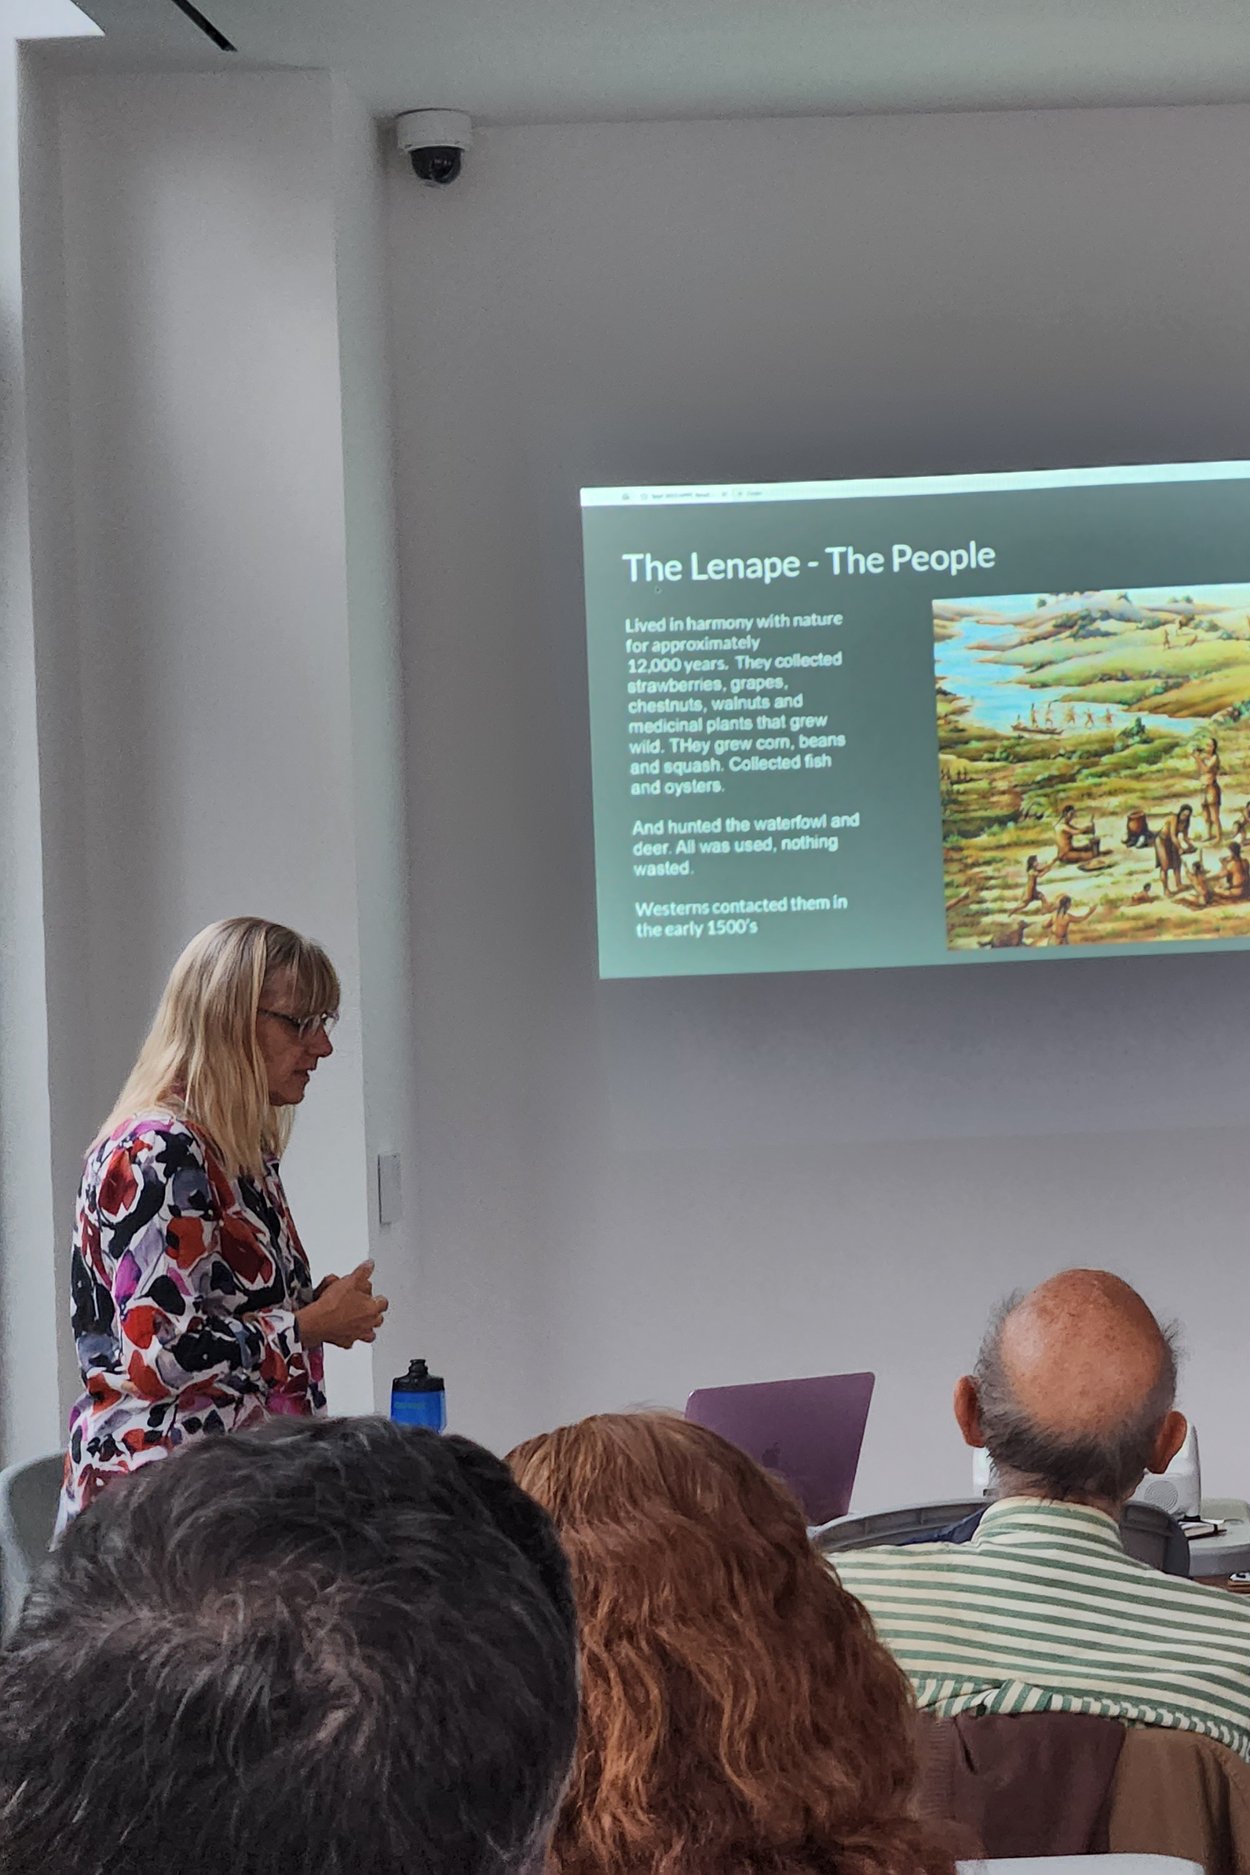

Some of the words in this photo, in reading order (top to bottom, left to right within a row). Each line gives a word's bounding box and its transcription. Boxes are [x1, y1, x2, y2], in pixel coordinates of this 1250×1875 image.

[622, 553, 682, 582] The
[691, 552, 800, 583] Lenape
[825, 546, 884, 574] The
[892, 541, 996, 575] People
[625, 618, 666, 633] Lived
[670, 617, 684, 631] in
[686, 615, 752, 632] harmony
[756, 614, 790, 629] with
[793, 613, 842, 627] nature
[626, 639, 648, 654] for
[652, 636, 760, 654] approximately
[628, 658, 681, 673] 12,000
[684, 658, 728, 673] years.
[735, 655, 771, 671] They
[775, 651, 842, 668] collected
[628, 678, 727, 694] strawberries,
[731, 677, 788, 692] grapes,
[629, 698, 707, 714] chestnuts,
[711, 696, 770, 711] walnuts
[774, 694, 803, 708] and
[629, 718, 702, 734] medicinal
[706, 716, 752, 734] plants
[757, 715, 786, 729] that
[790, 714, 827, 731] grew
[629, 739, 665, 754] wild.
[714, 736, 752, 754] grew
[756, 737, 795, 752] corn,
[799, 734, 845, 749] beans
[630, 759, 660, 775] and
[664, 757, 724, 775] squash.
[729, 755, 801, 772] Collected
[804, 753, 832, 768] fish
[631, 780, 660, 795] and
[664, 780, 724, 796] oysters.
[632, 820, 664, 835] And
[668, 818, 722, 834] hunted
[726, 817, 750, 832] the
[754, 814, 826, 830] waterfowl
[831, 813, 860, 828] and
[633, 840, 671, 856] deer.
[675, 839, 696, 854] All
[700, 840, 730, 853] was
[734, 837, 777, 853] used,
[781, 835, 839, 852] nothing
[634, 860, 694, 876] wasted.
[635, 900, 709, 917] Westerns
[713, 897, 788, 914] contacted
[790, 896, 830, 912] them
[833, 895, 847, 910] in
[636, 922, 663, 937] the
[665, 922, 704, 938] early
